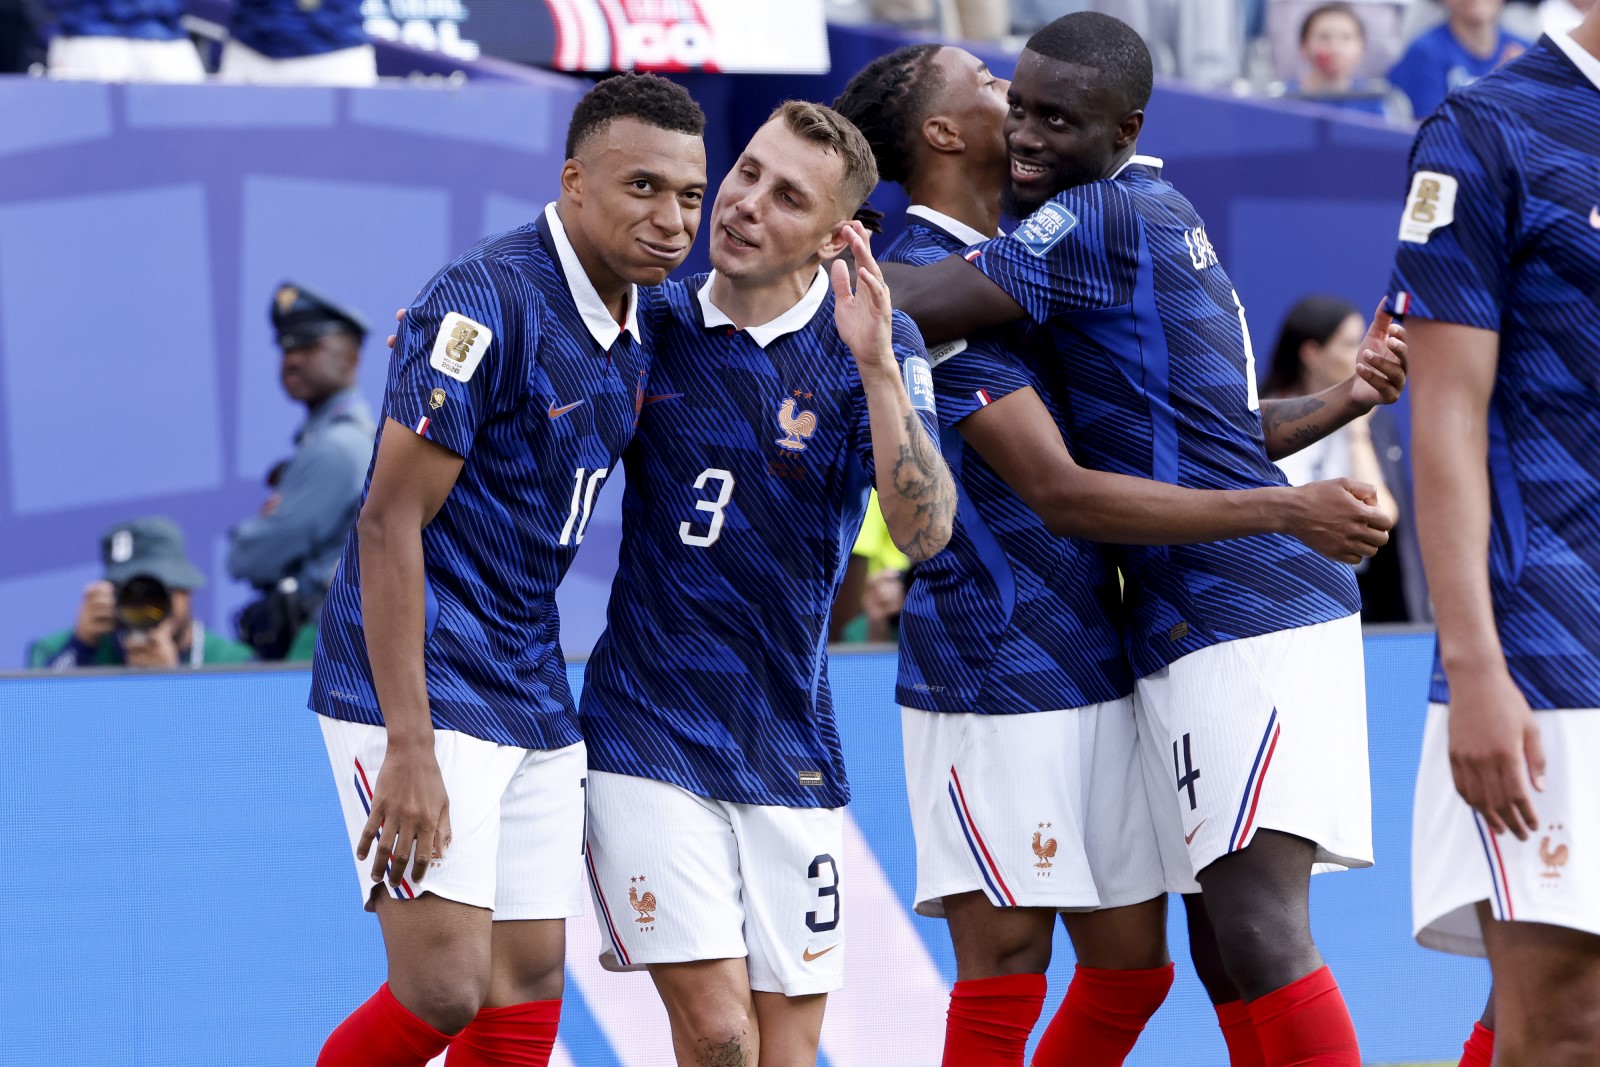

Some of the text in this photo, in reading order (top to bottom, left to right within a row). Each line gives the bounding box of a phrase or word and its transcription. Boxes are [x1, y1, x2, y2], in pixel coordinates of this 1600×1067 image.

[933, 345, 955, 360] 2026
[679, 468, 735, 547] 3
[1173, 732, 1200, 811] 4
[805, 853, 840, 932] 3
